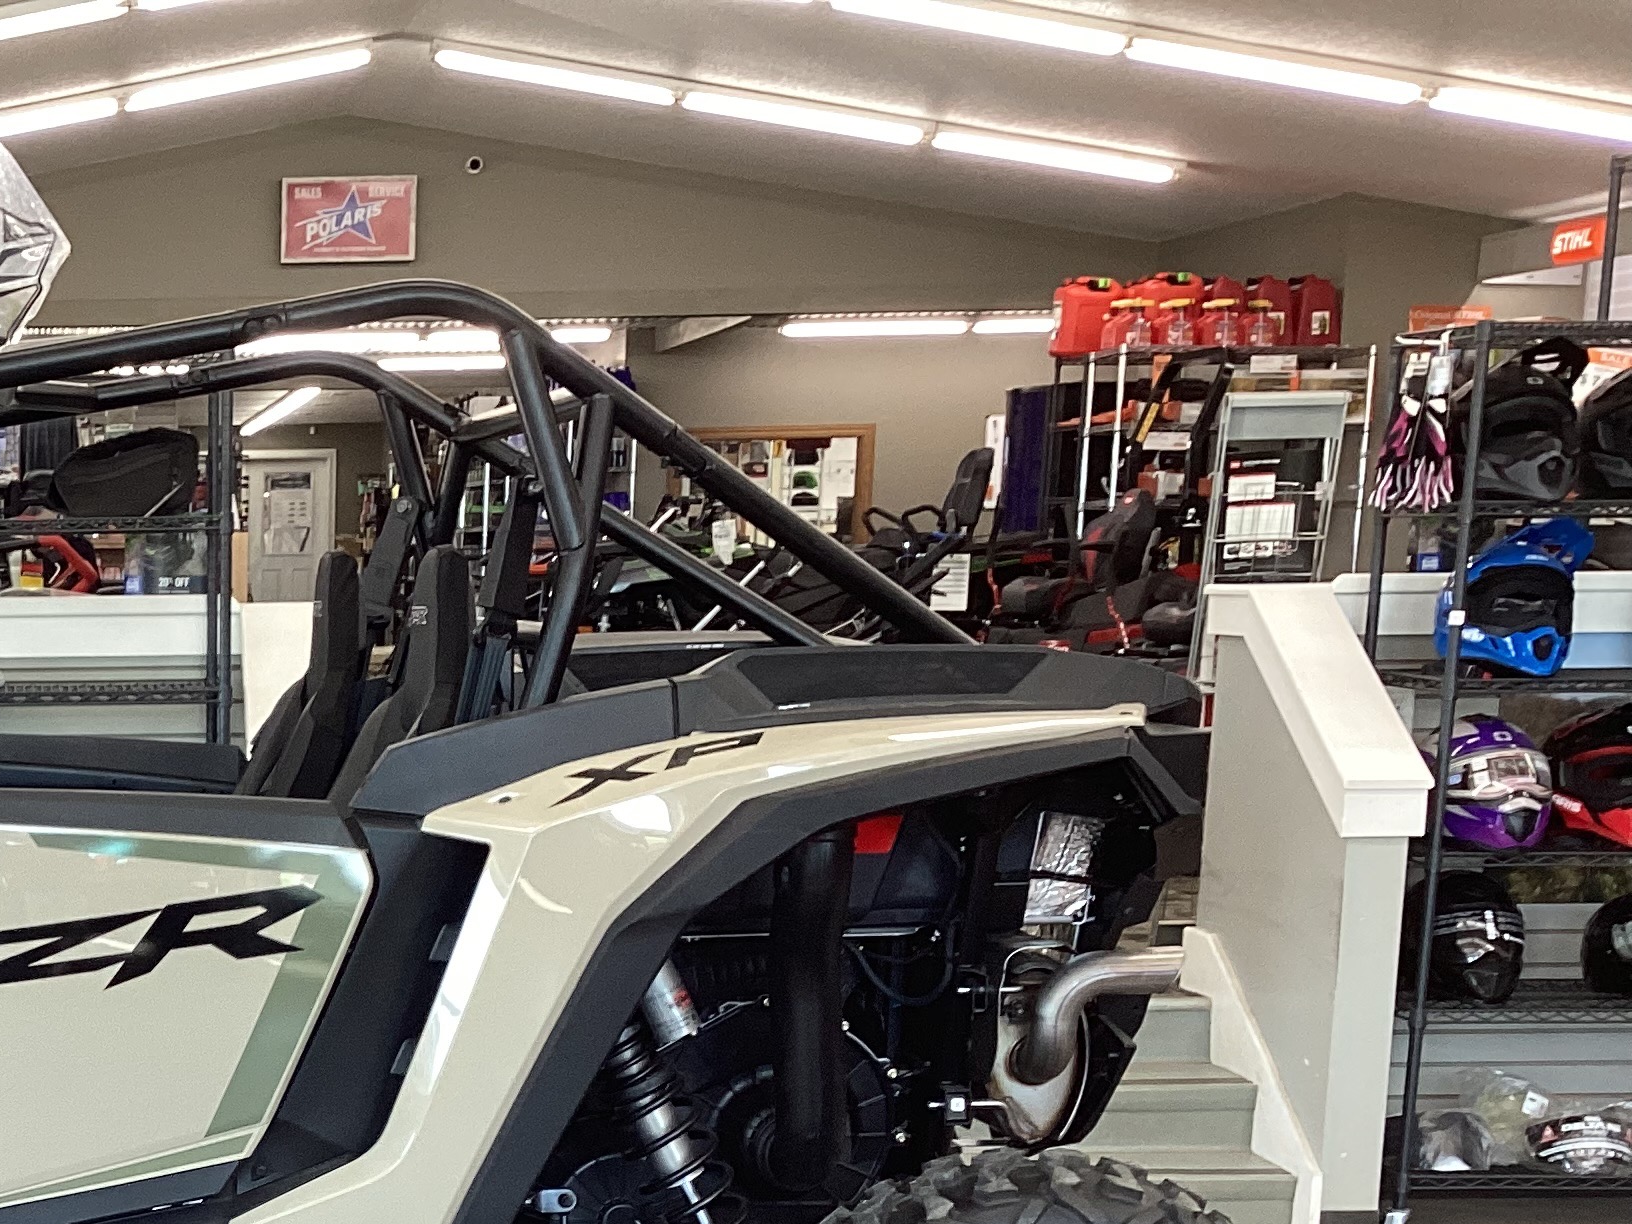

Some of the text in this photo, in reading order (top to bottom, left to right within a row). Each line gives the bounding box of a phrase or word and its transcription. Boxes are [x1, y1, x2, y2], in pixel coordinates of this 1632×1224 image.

[294, 186, 322, 199] SALES
[368, 183, 406, 197] SERVICE
[304, 203, 383, 243] POLARIS
[1551, 226, 1594, 255] STIHL
[548, 731, 765, 809] XP
